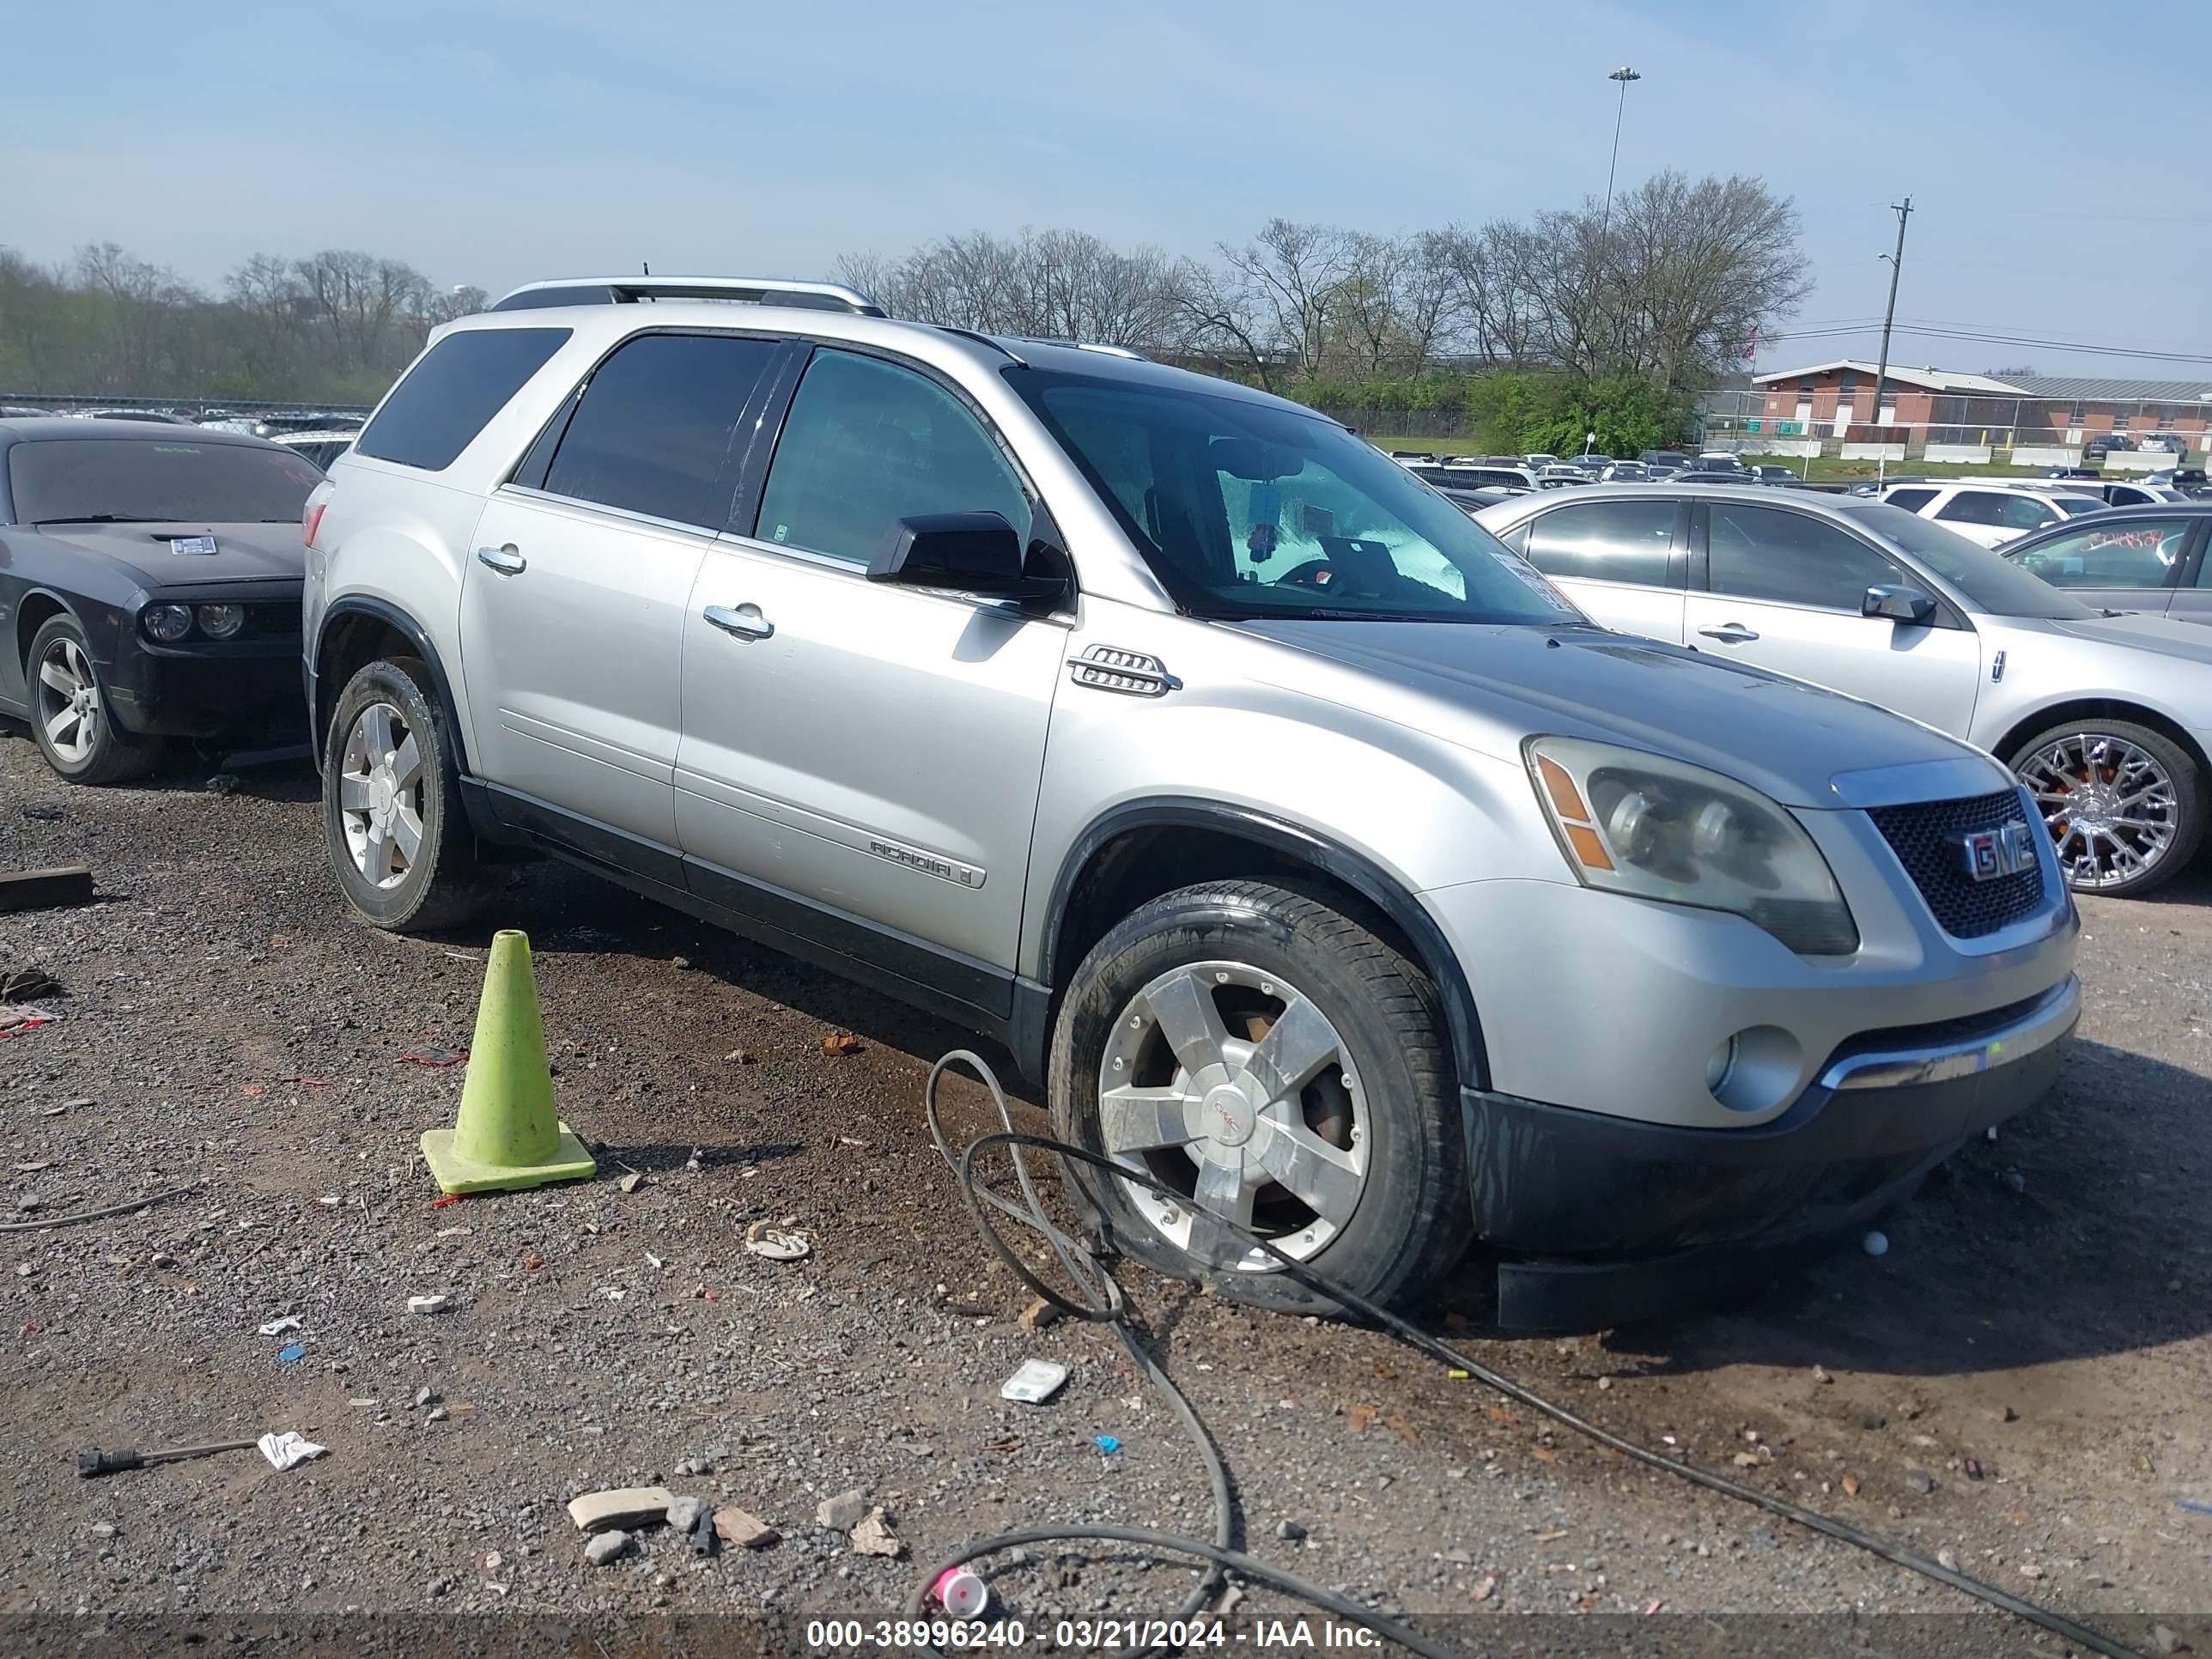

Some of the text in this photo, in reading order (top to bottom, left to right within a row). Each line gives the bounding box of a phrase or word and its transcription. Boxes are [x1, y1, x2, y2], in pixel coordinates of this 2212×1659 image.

[870, 841, 951, 877] ACADIA
[1964, 819, 2035, 882] GMC
[1214, 1100, 1240, 1133] GMC
